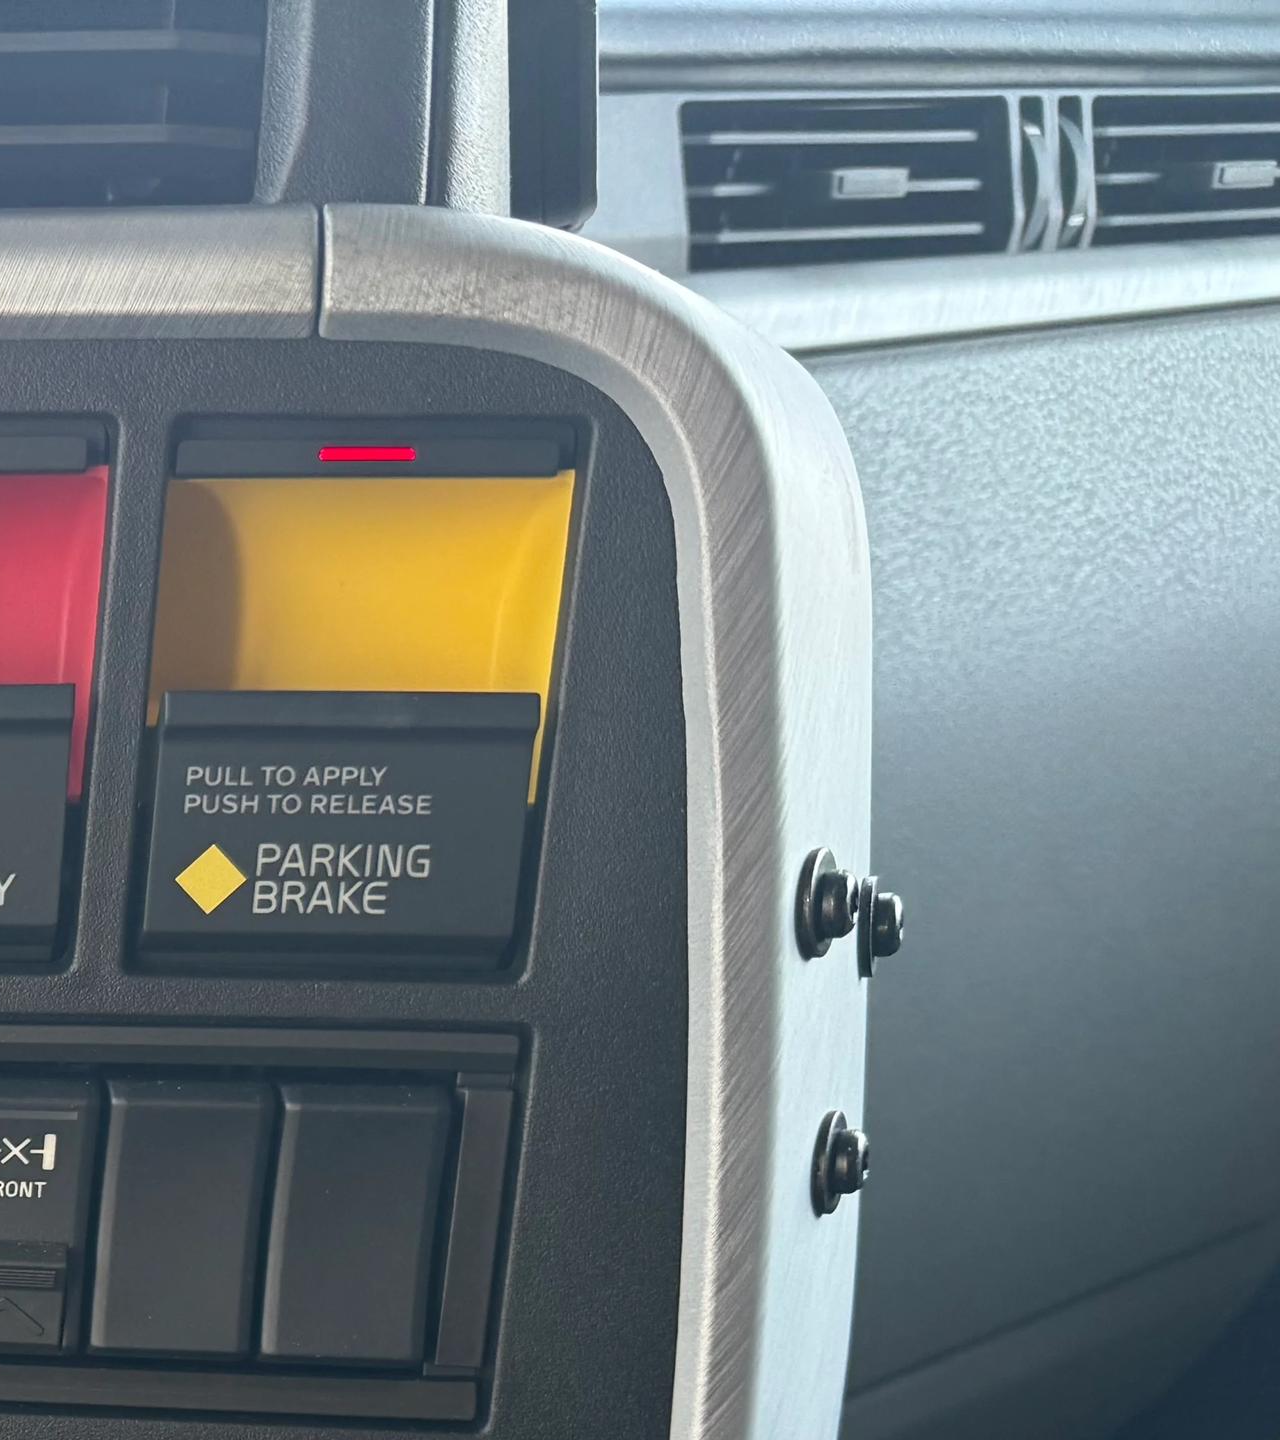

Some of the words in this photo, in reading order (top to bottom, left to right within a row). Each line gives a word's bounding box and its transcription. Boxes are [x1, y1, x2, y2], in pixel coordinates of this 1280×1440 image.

[186, 765, 255, 788] PULL
[260, 765, 296, 787] TO
[302, 766, 388, 786] APPLY
[183, 792, 263, 815] PUSH
[267, 793, 302, 815] TO
[310, 794, 432, 815] RELEASE
[255, 843, 431, 878] PARKING
[252, 880, 389, 915] BRAKE
